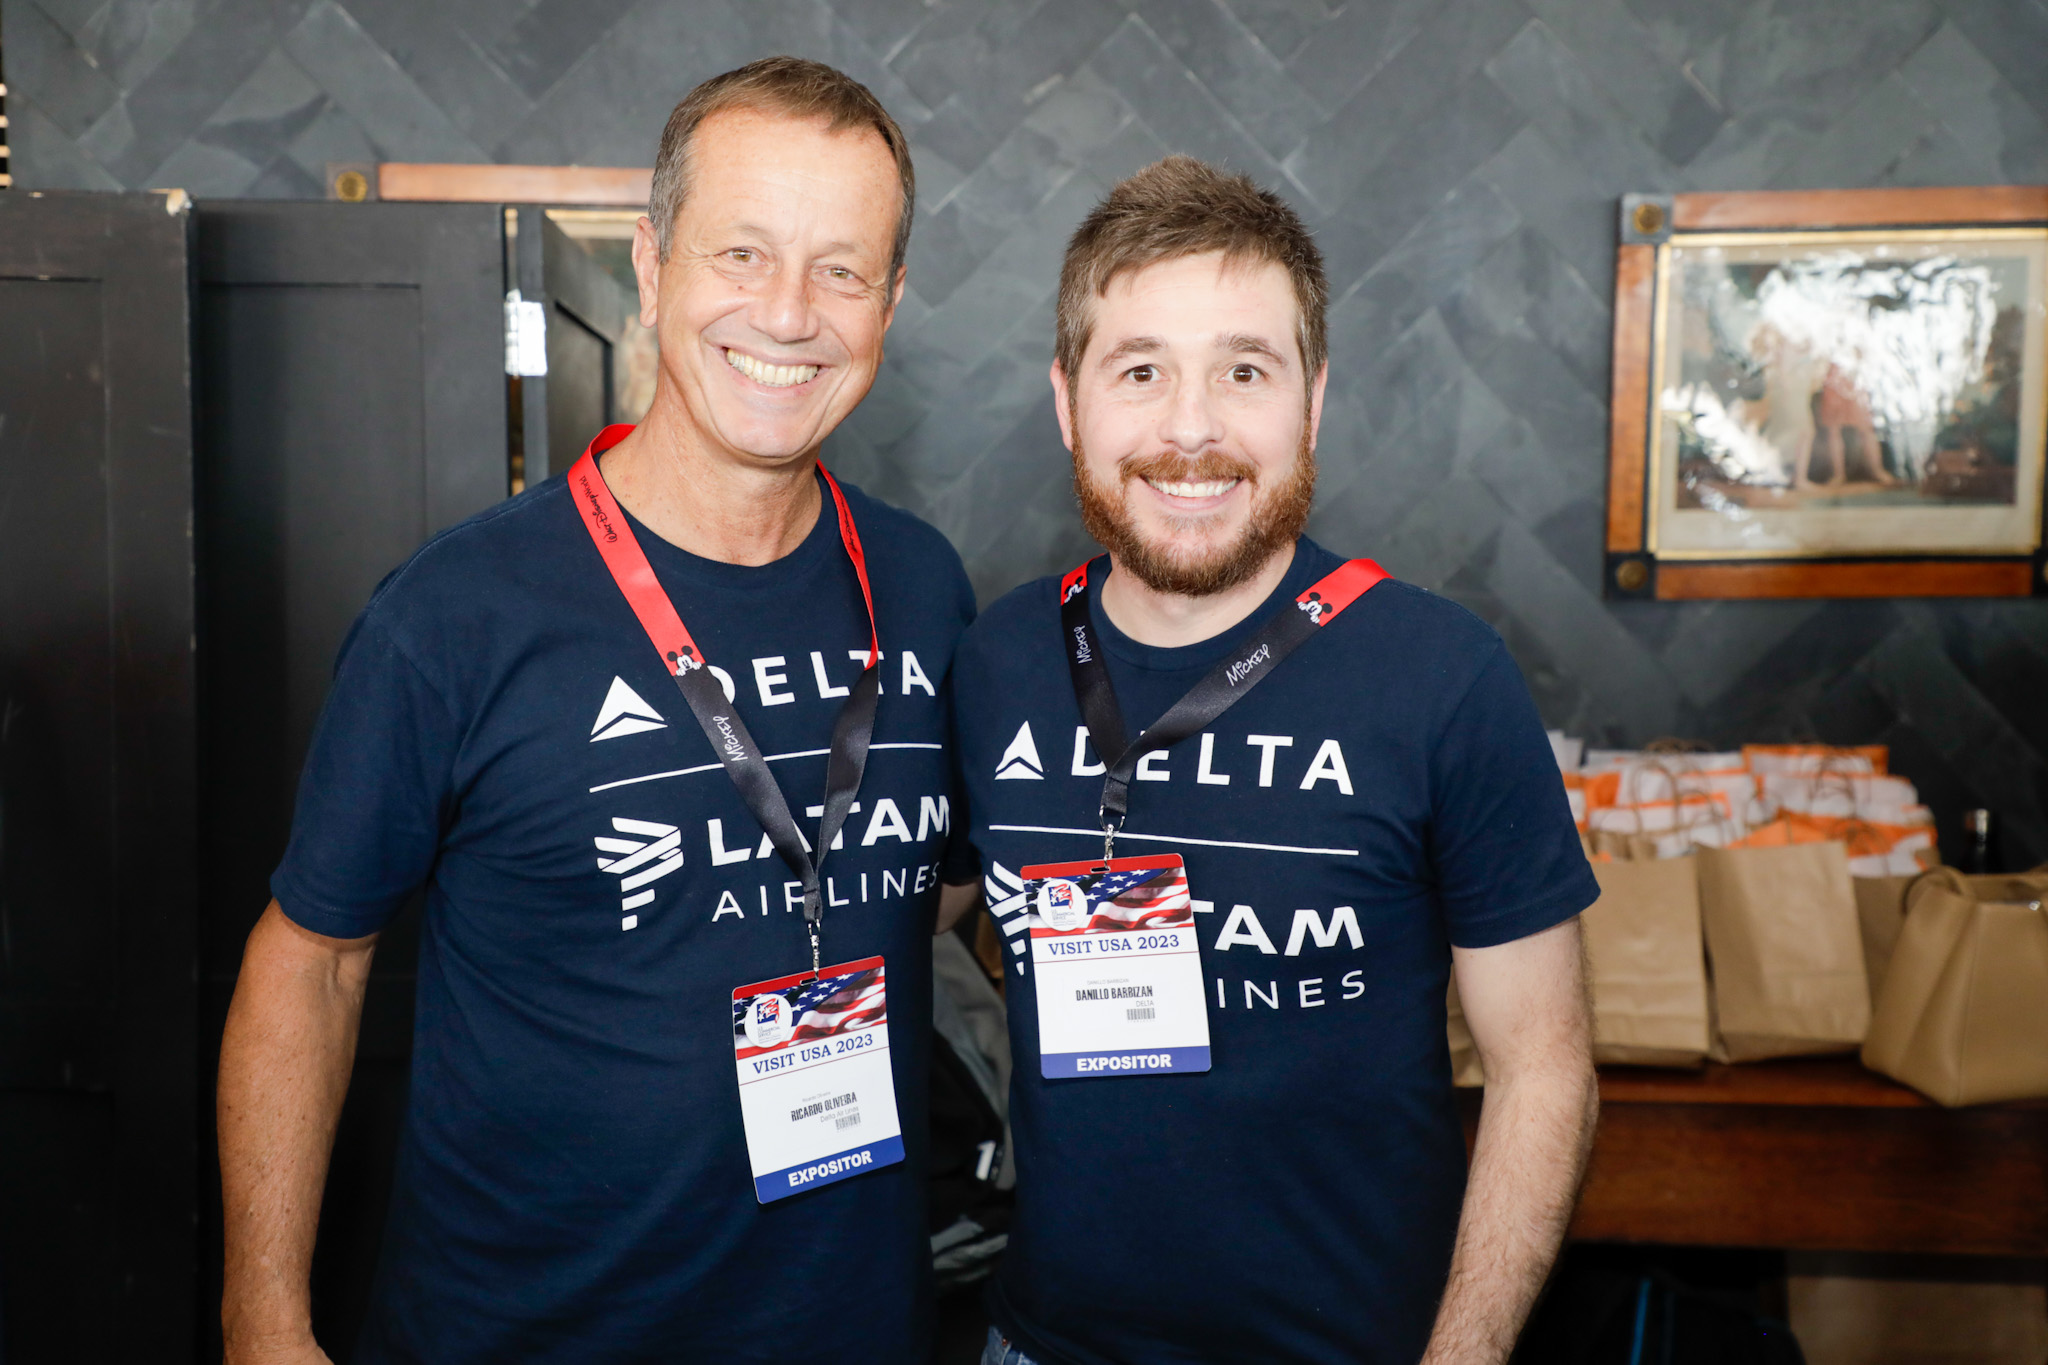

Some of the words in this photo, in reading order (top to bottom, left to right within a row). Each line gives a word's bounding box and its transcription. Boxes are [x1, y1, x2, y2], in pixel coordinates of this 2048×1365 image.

[591, 494, 608, 528] Disney
[1071, 725, 1355, 796] DELTA
[711, 861, 941, 923] AIRLINES
[1048, 940, 1092, 956] VISIT
[1098, 938, 1132, 952] USA
[1137, 934, 1180, 949] 2023
[1075, 988, 1110, 1002] DANILLO
[1111, 985, 1153, 1000] BARBIZAN
[1136, 1000, 1154, 1008] DELTA
[1217, 970, 1366, 1010] INES
[753, 1052, 796, 1075] VISIT
[800, 1044, 832, 1062] USA
[836, 1033, 873, 1054] 2023
[1076, 1053, 1173, 1072] EXPOSITOR
[791, 1102, 824, 1122] RICARDO
[824, 1092, 858, 1112] OLIVEIRA
[787, 1150, 873, 1187] EXPOSITOR
